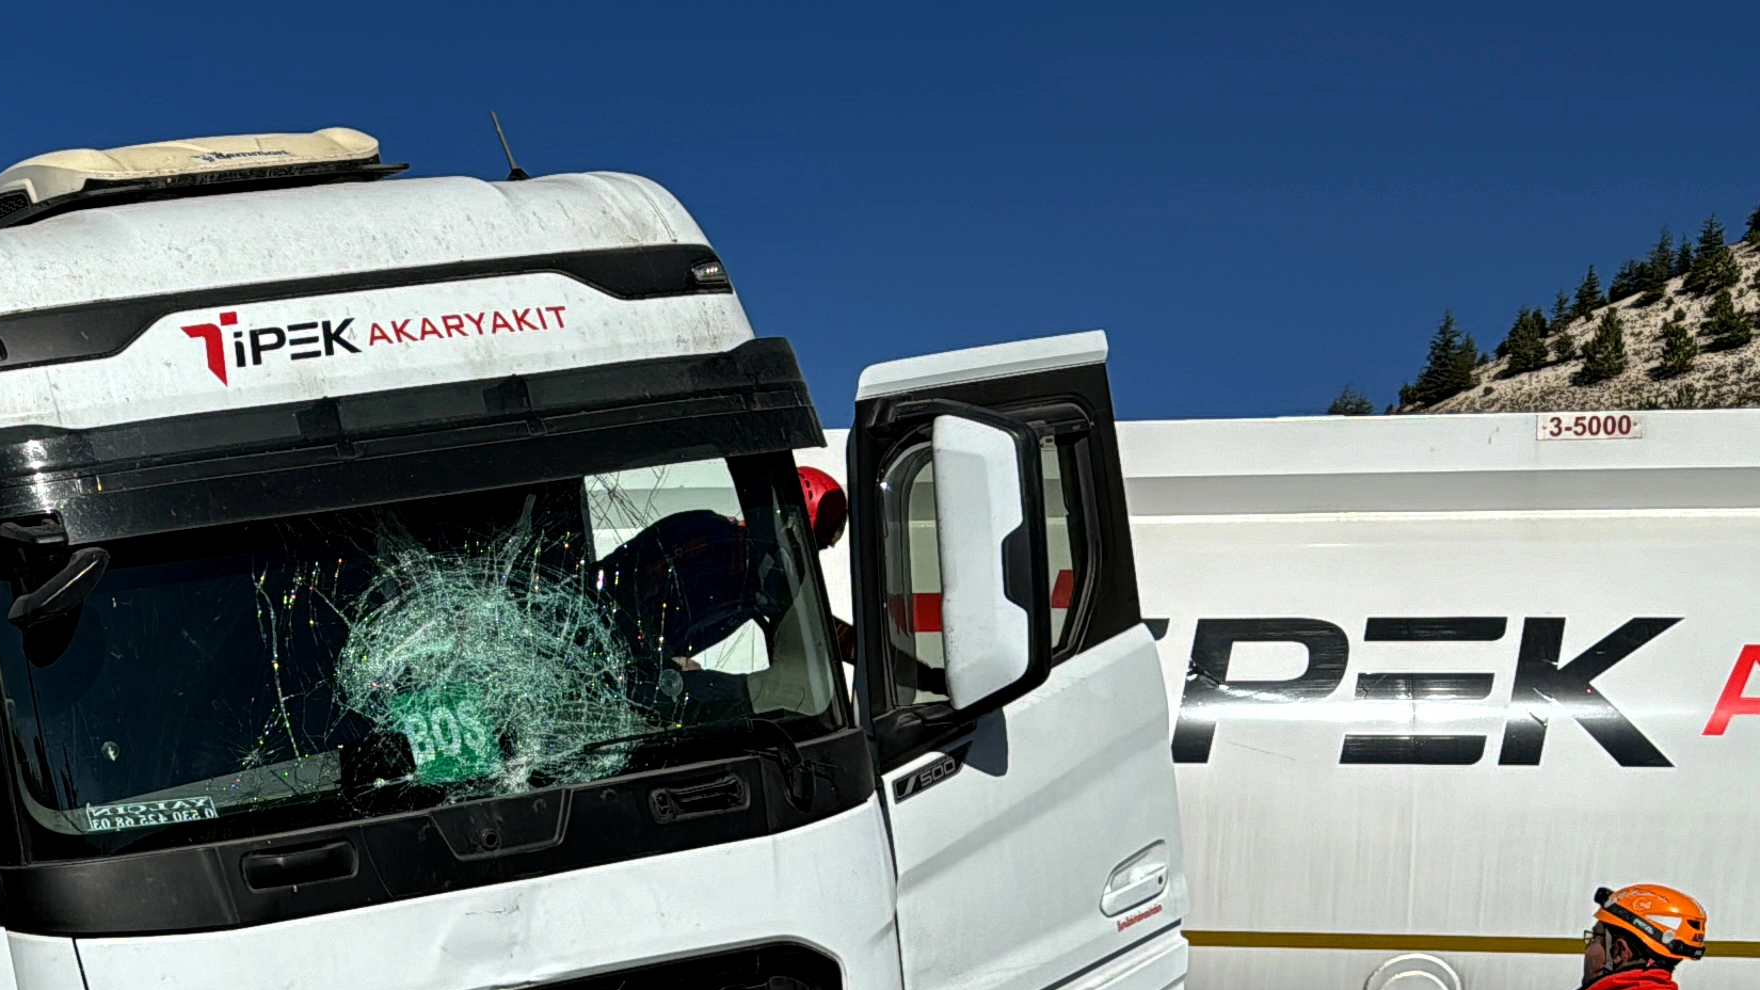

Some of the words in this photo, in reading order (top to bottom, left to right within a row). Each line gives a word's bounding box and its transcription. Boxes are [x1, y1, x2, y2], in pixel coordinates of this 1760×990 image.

[368, 305, 567, 347] AKARYAKIT
[1549, 414, 1632, 437] 3-5000
[1143, 617, 1685, 767] PEK
[920, 758, 956, 787] 500
